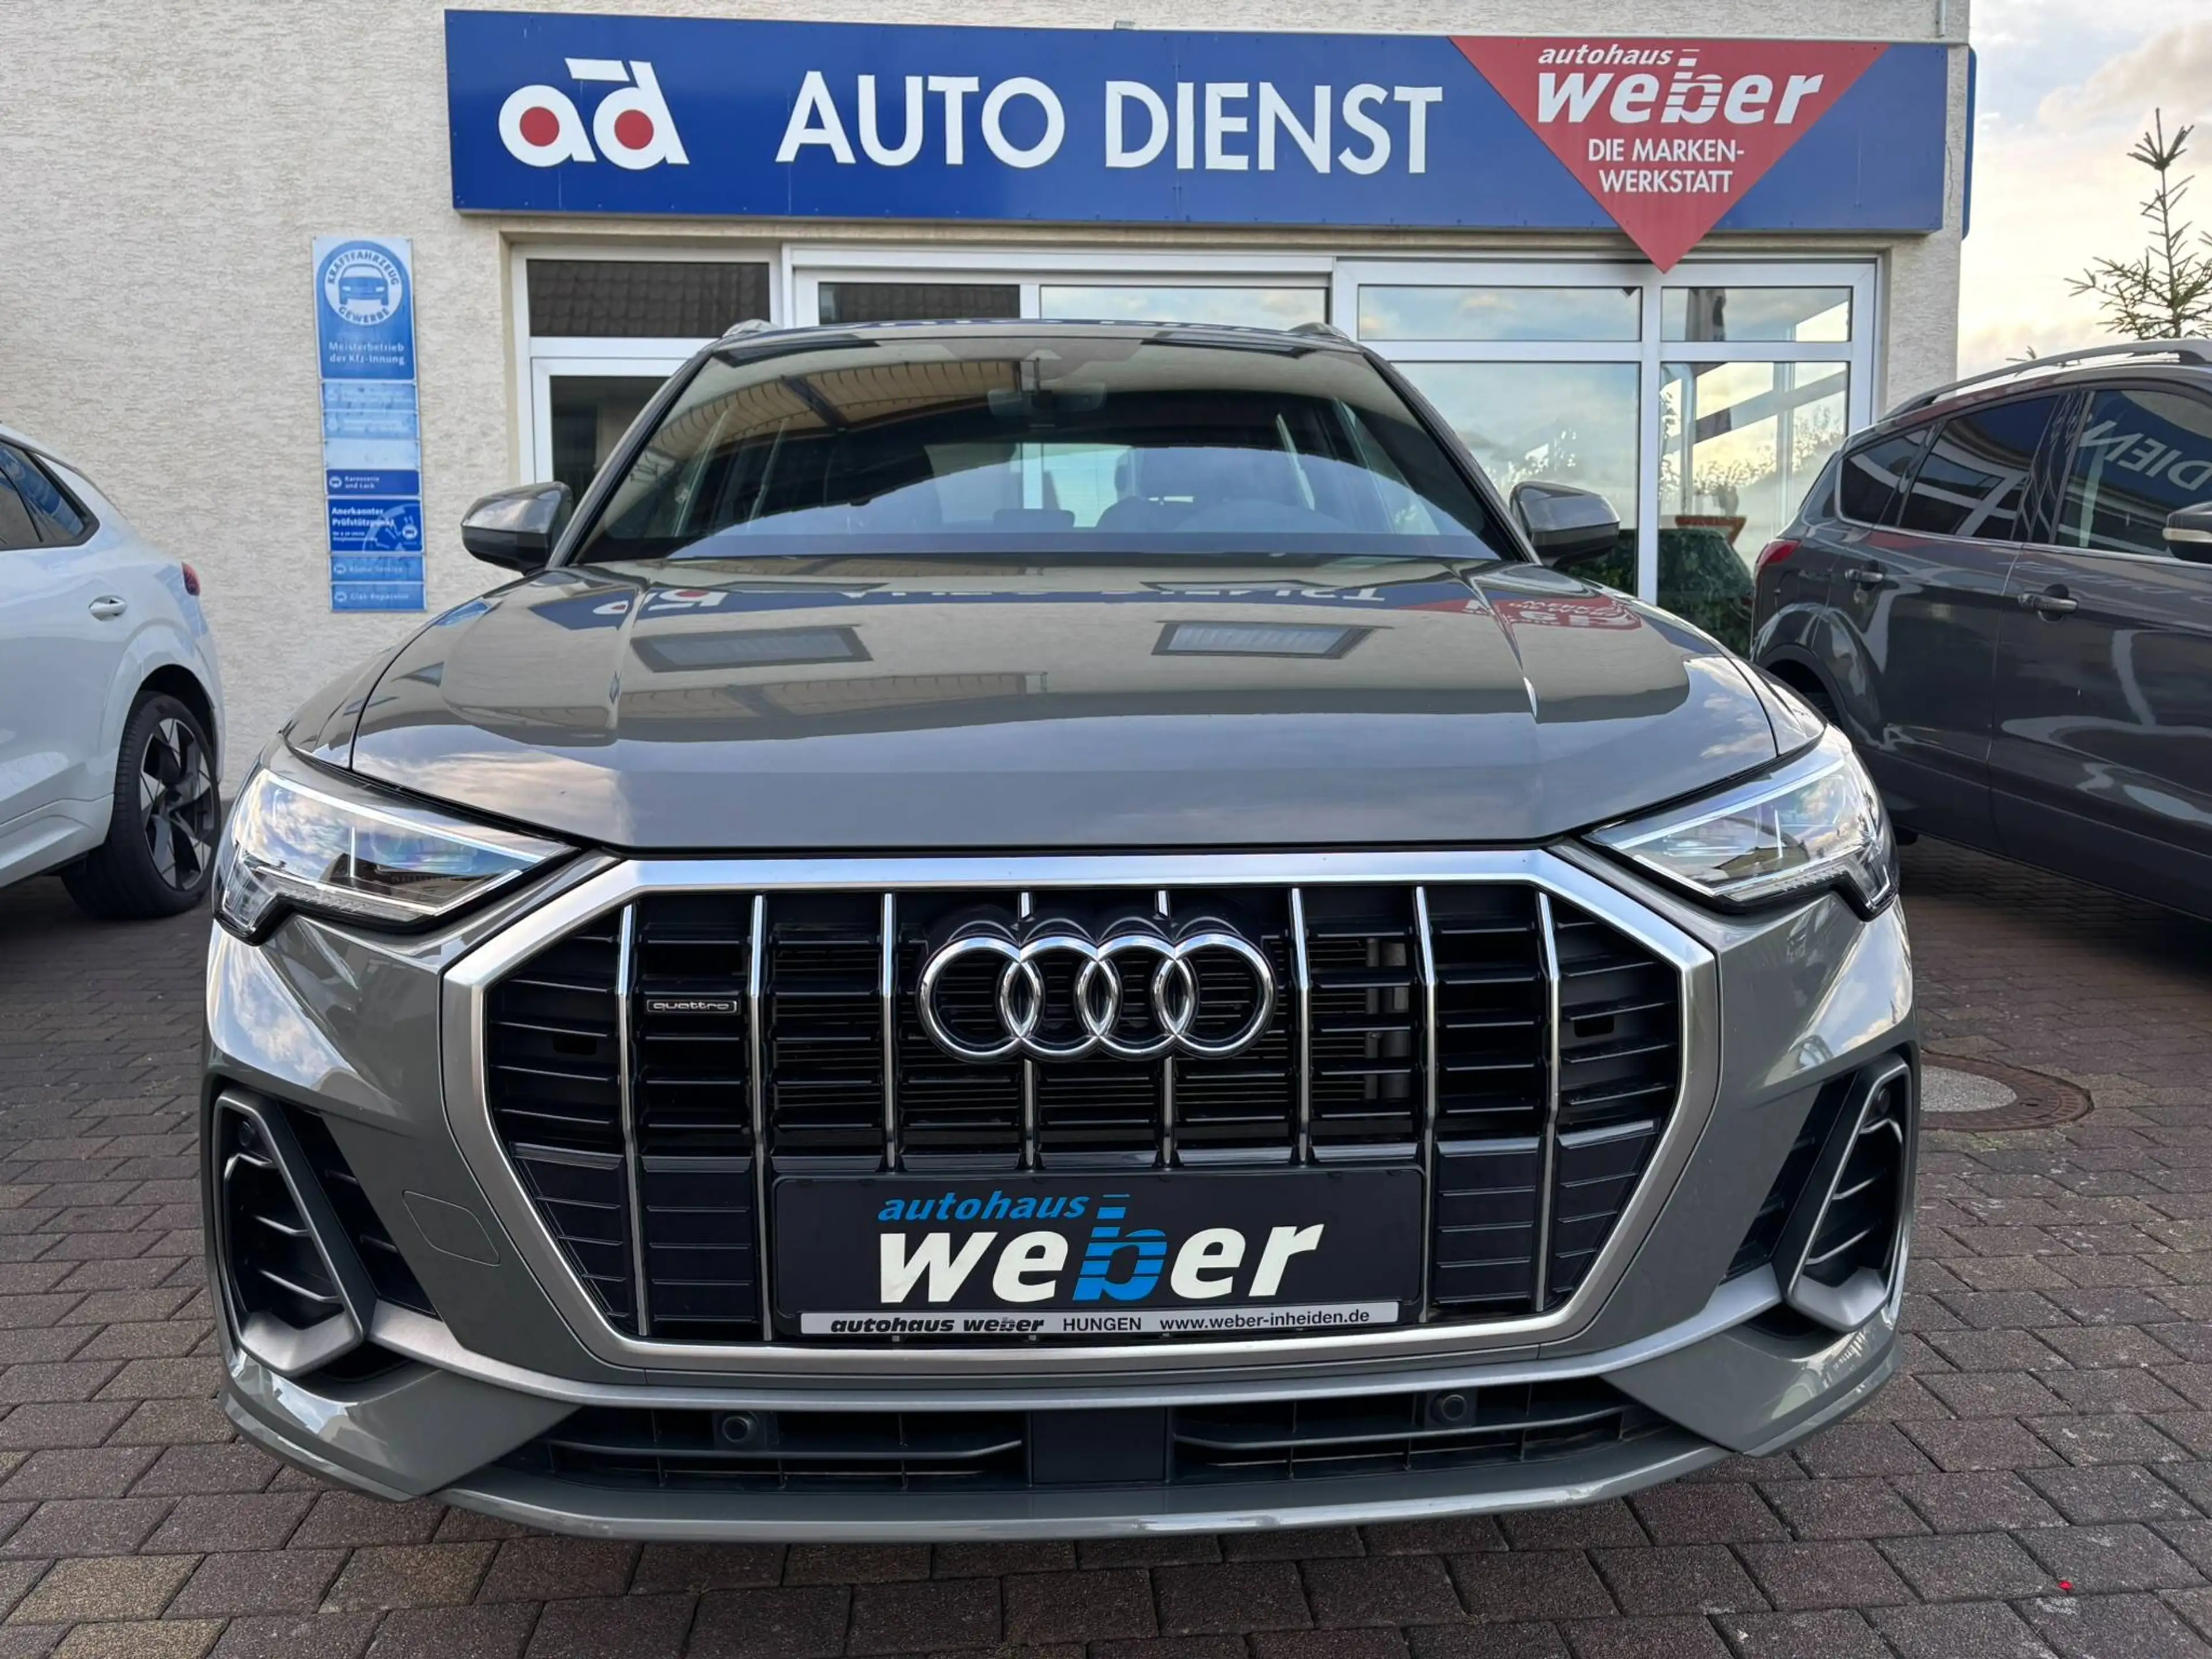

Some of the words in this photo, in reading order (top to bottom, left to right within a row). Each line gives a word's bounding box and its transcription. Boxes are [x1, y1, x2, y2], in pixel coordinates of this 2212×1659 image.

[1538, 44, 1673, 65] autohaus
[1538, 49, 1824, 124] weber
[775, 71, 1065, 168] AUTO
[1105, 81, 1442, 175] DIENST
[1589, 138, 1624, 162] DIE
[1632, 138, 1744, 162] MARKEN-
[1599, 169, 1733, 192] WERKSTATT
[327, 251, 399, 286] KRAFTFAHRZEUG
[339, 305, 390, 323] GEWERBE
[328, 341, 404, 352] Meisterbetrieb
[329, 353, 346, 363] der
[349, 354, 405, 366] Kfz-Innung
[332, 506, 384, 516] Anerkannter
[653, 1002, 730, 1012] quattro
[878, 1190, 1089, 1220] autohaus
[880, 1194, 1324, 1303] weber
[831, 1317, 955, 1332] autohaus
[963, 1317, 1044, 1332] weber
[1063, 1317, 1142, 1332] HUNGEN
[1160, 1309, 1370, 1330] www.weber-inheiden.de
